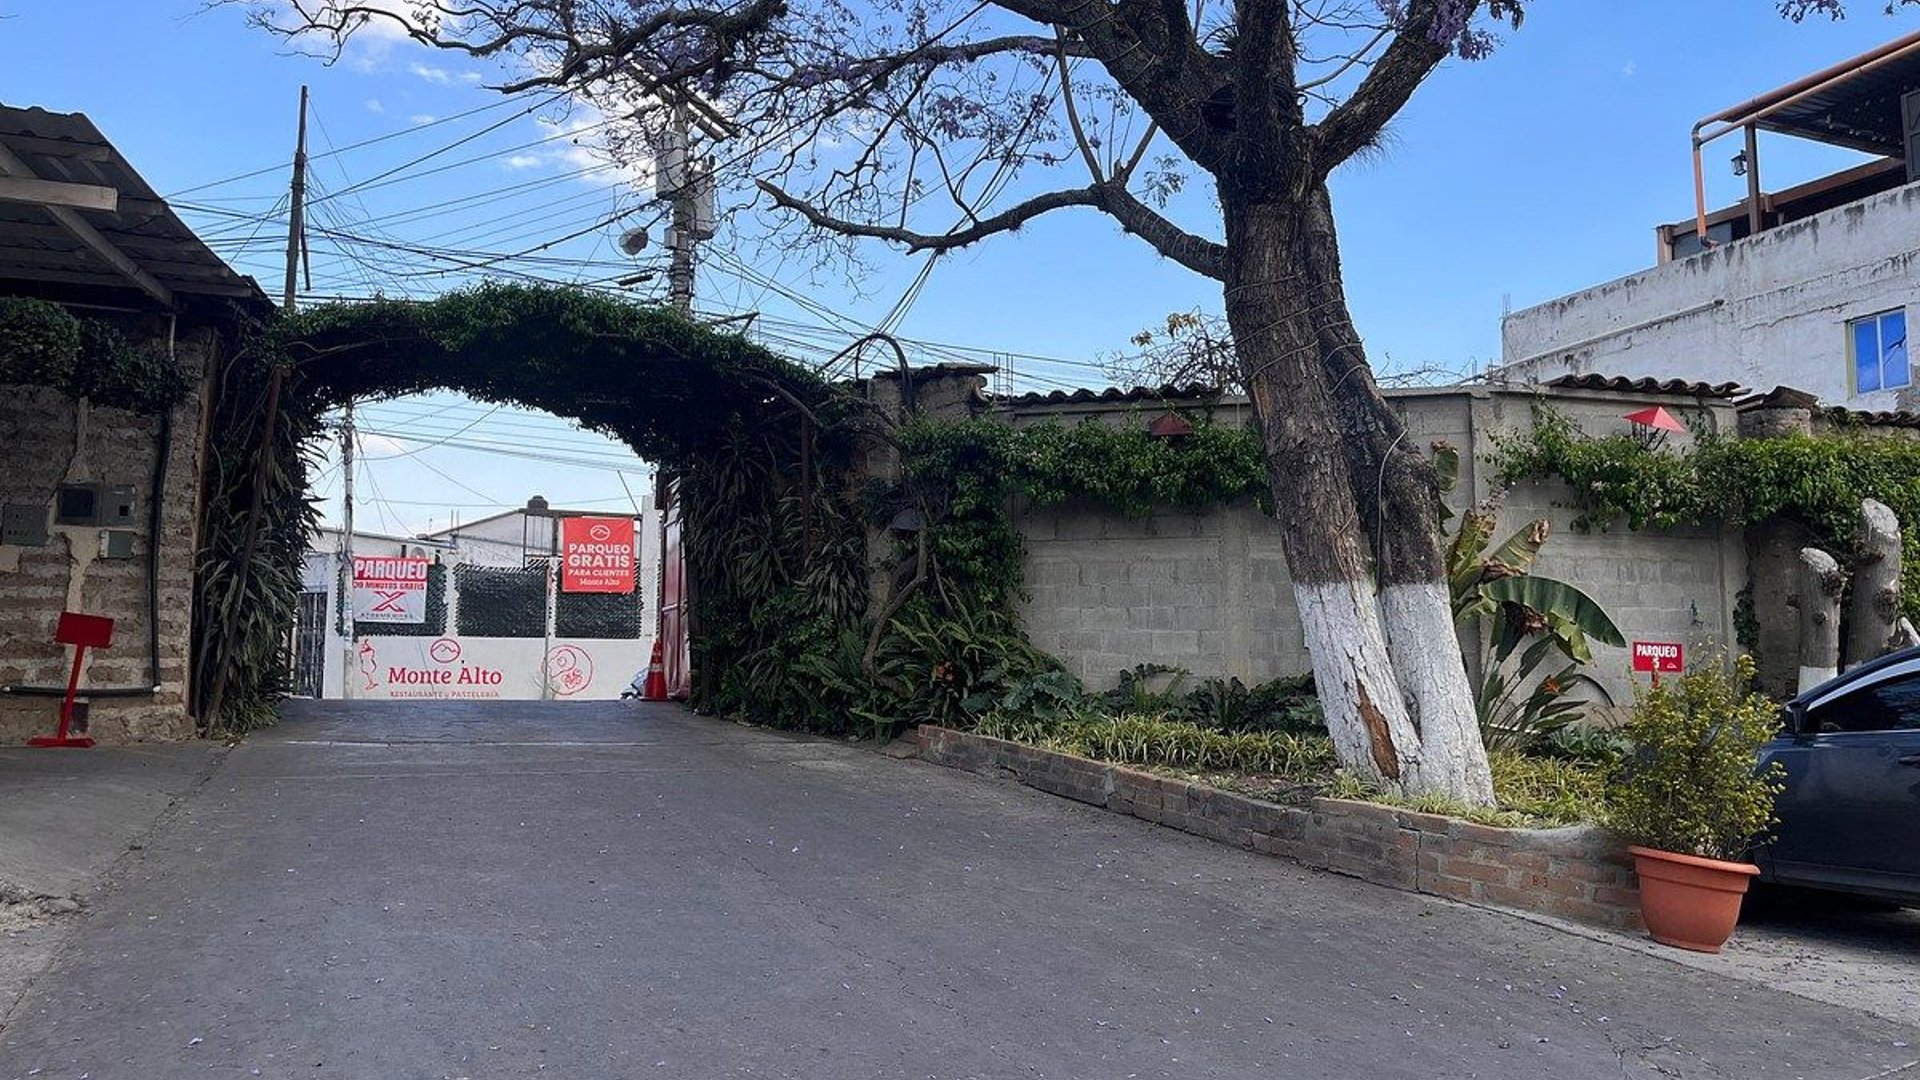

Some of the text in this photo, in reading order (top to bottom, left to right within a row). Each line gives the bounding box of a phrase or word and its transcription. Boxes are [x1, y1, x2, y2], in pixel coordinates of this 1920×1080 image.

[569, 543, 630, 555] PARQUEO
[568, 554, 630, 568] GRATIS
[354, 560, 427, 579] PARQUEO
[592, 569, 629, 577] CLIENTES
[1636, 644, 1678, 658] PARQUEO
[388, 666, 502, 685] Monte Alto
